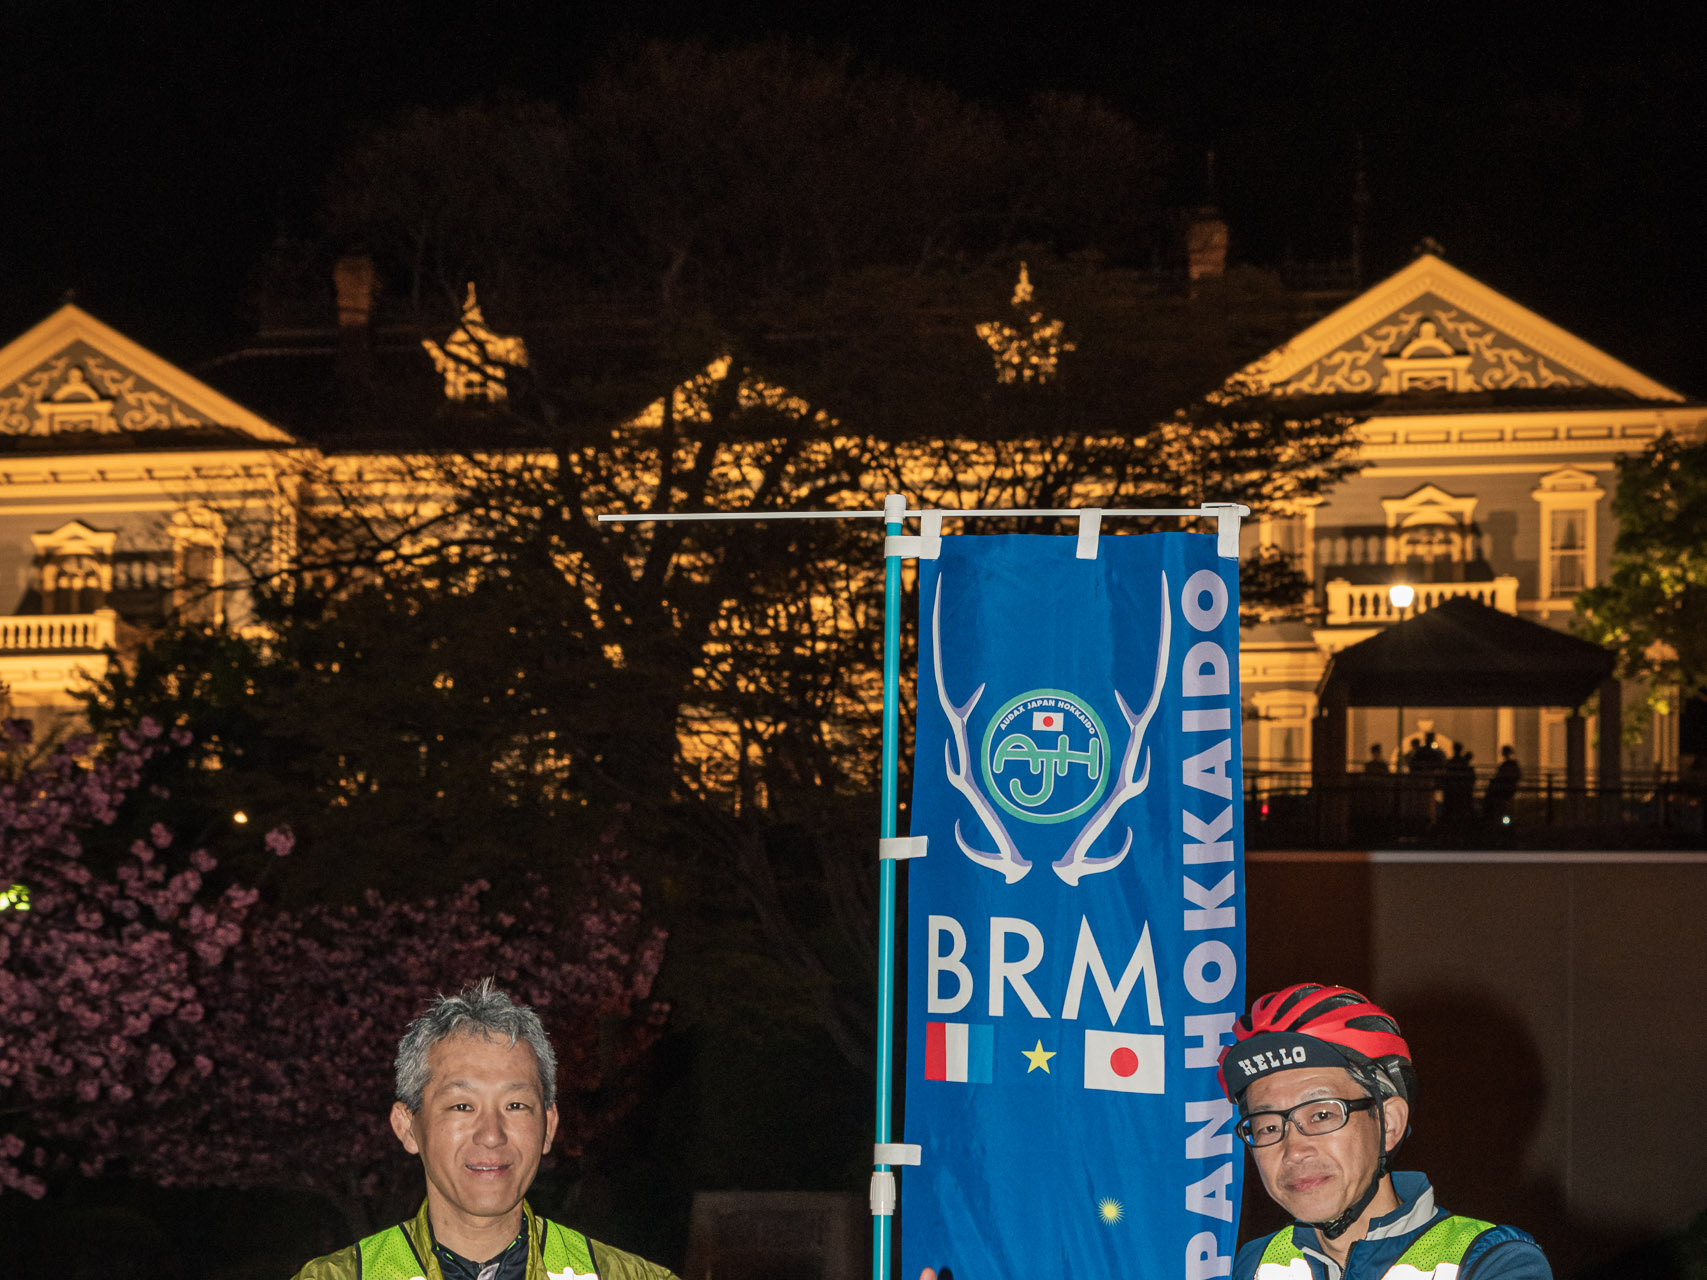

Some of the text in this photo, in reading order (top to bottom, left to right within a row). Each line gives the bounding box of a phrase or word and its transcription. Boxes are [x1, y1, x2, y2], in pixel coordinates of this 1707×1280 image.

[1000, 699, 1095, 733] AUDAX JAPAN HOKKAIDO
[993, 733, 1099, 806] AJH
[1181, 569, 1237, 1068] HOKKAIDO
[927, 913, 1165, 1027] BRM
[1238, 1046, 1306, 1076] HELLO
